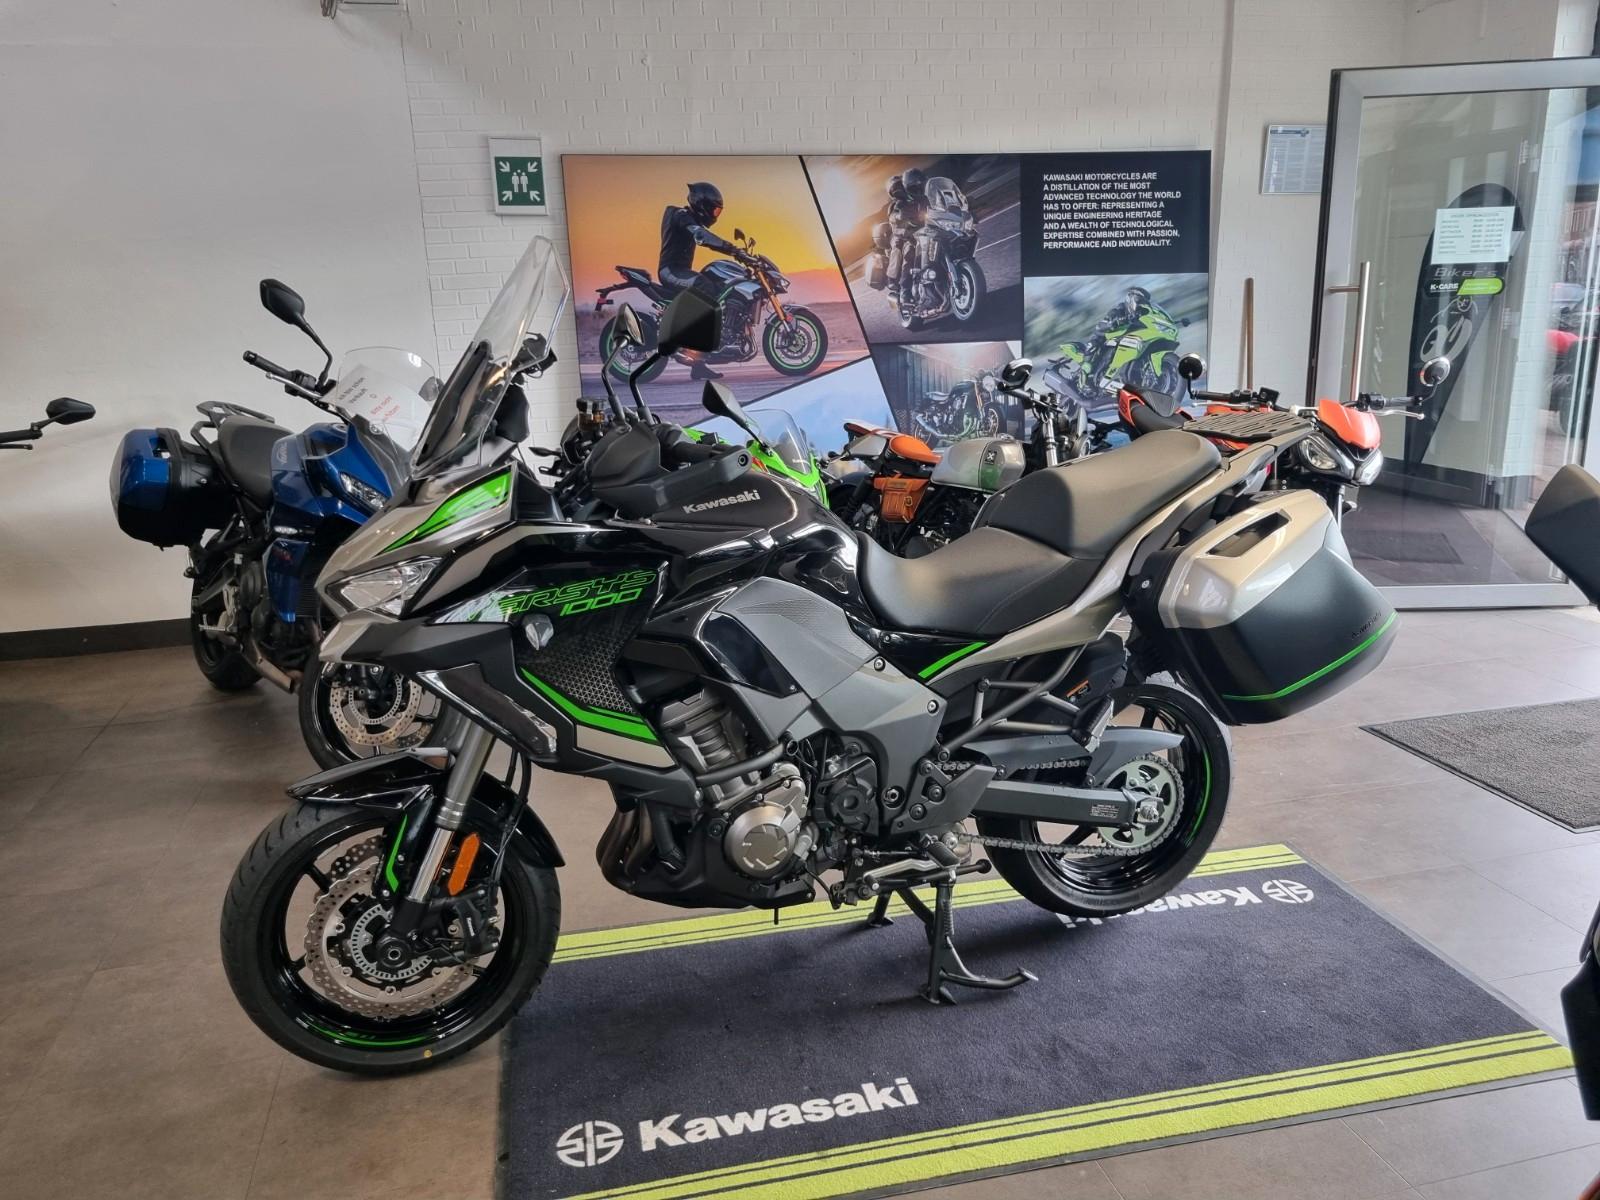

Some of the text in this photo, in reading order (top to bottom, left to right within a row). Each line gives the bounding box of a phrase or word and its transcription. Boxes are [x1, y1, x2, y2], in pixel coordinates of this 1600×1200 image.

[1085, 173, 1140, 181] MOTORCYCLES
[1043, 193, 1084, 201] ADVANCED
[1086, 192, 1136, 200] TECHNOLOGY
[1112, 220, 1173, 228] TECHNOLOGICAL
[1044, 241, 1100, 249] PERFORMANCE
[683, 489, 760, 514] Kawasaki
[560, 587, 642, 617] 1000
[1055, 885, 1263, 929] Kawai
[639, 1077, 919, 1152] Kawasaki
